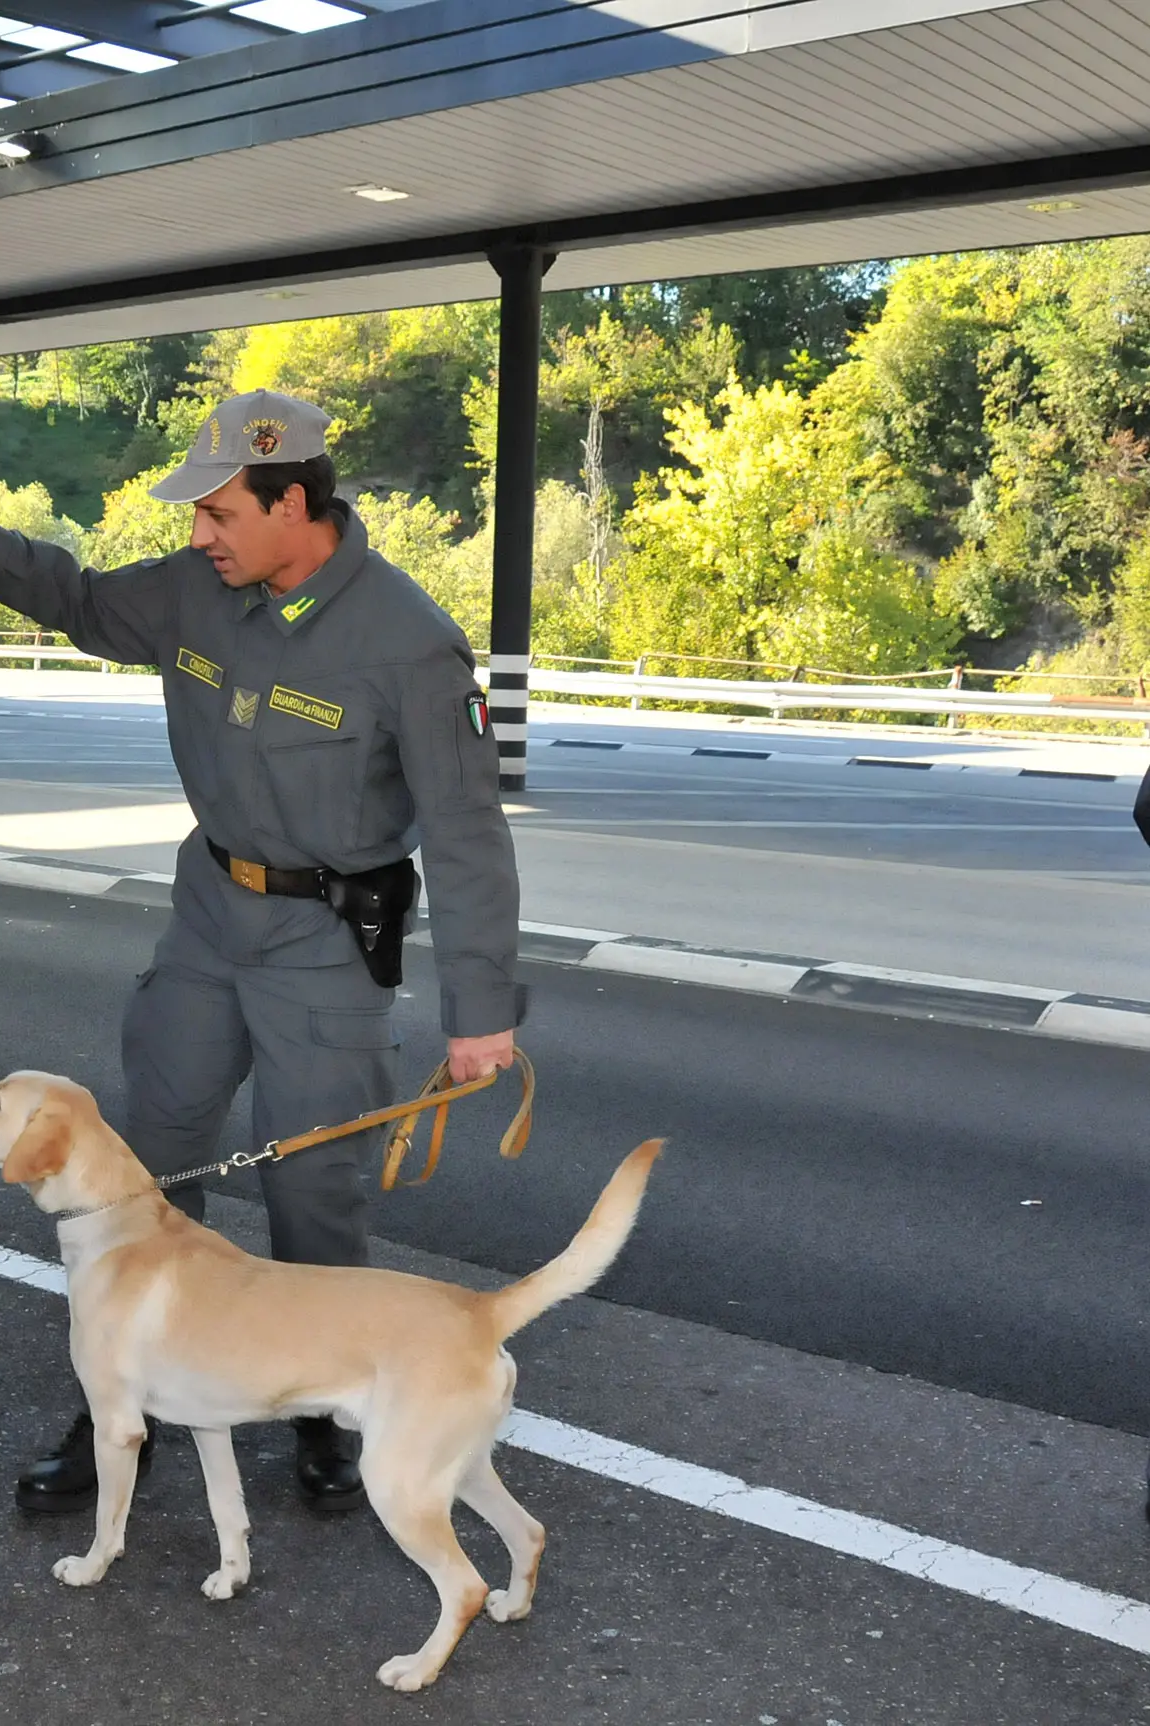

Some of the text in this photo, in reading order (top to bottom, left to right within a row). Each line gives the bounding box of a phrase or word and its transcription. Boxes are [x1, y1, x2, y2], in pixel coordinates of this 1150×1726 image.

[242, 419, 288, 434] CINOFILI
[274, 692, 338, 725] GUARDIA di FINANZA
